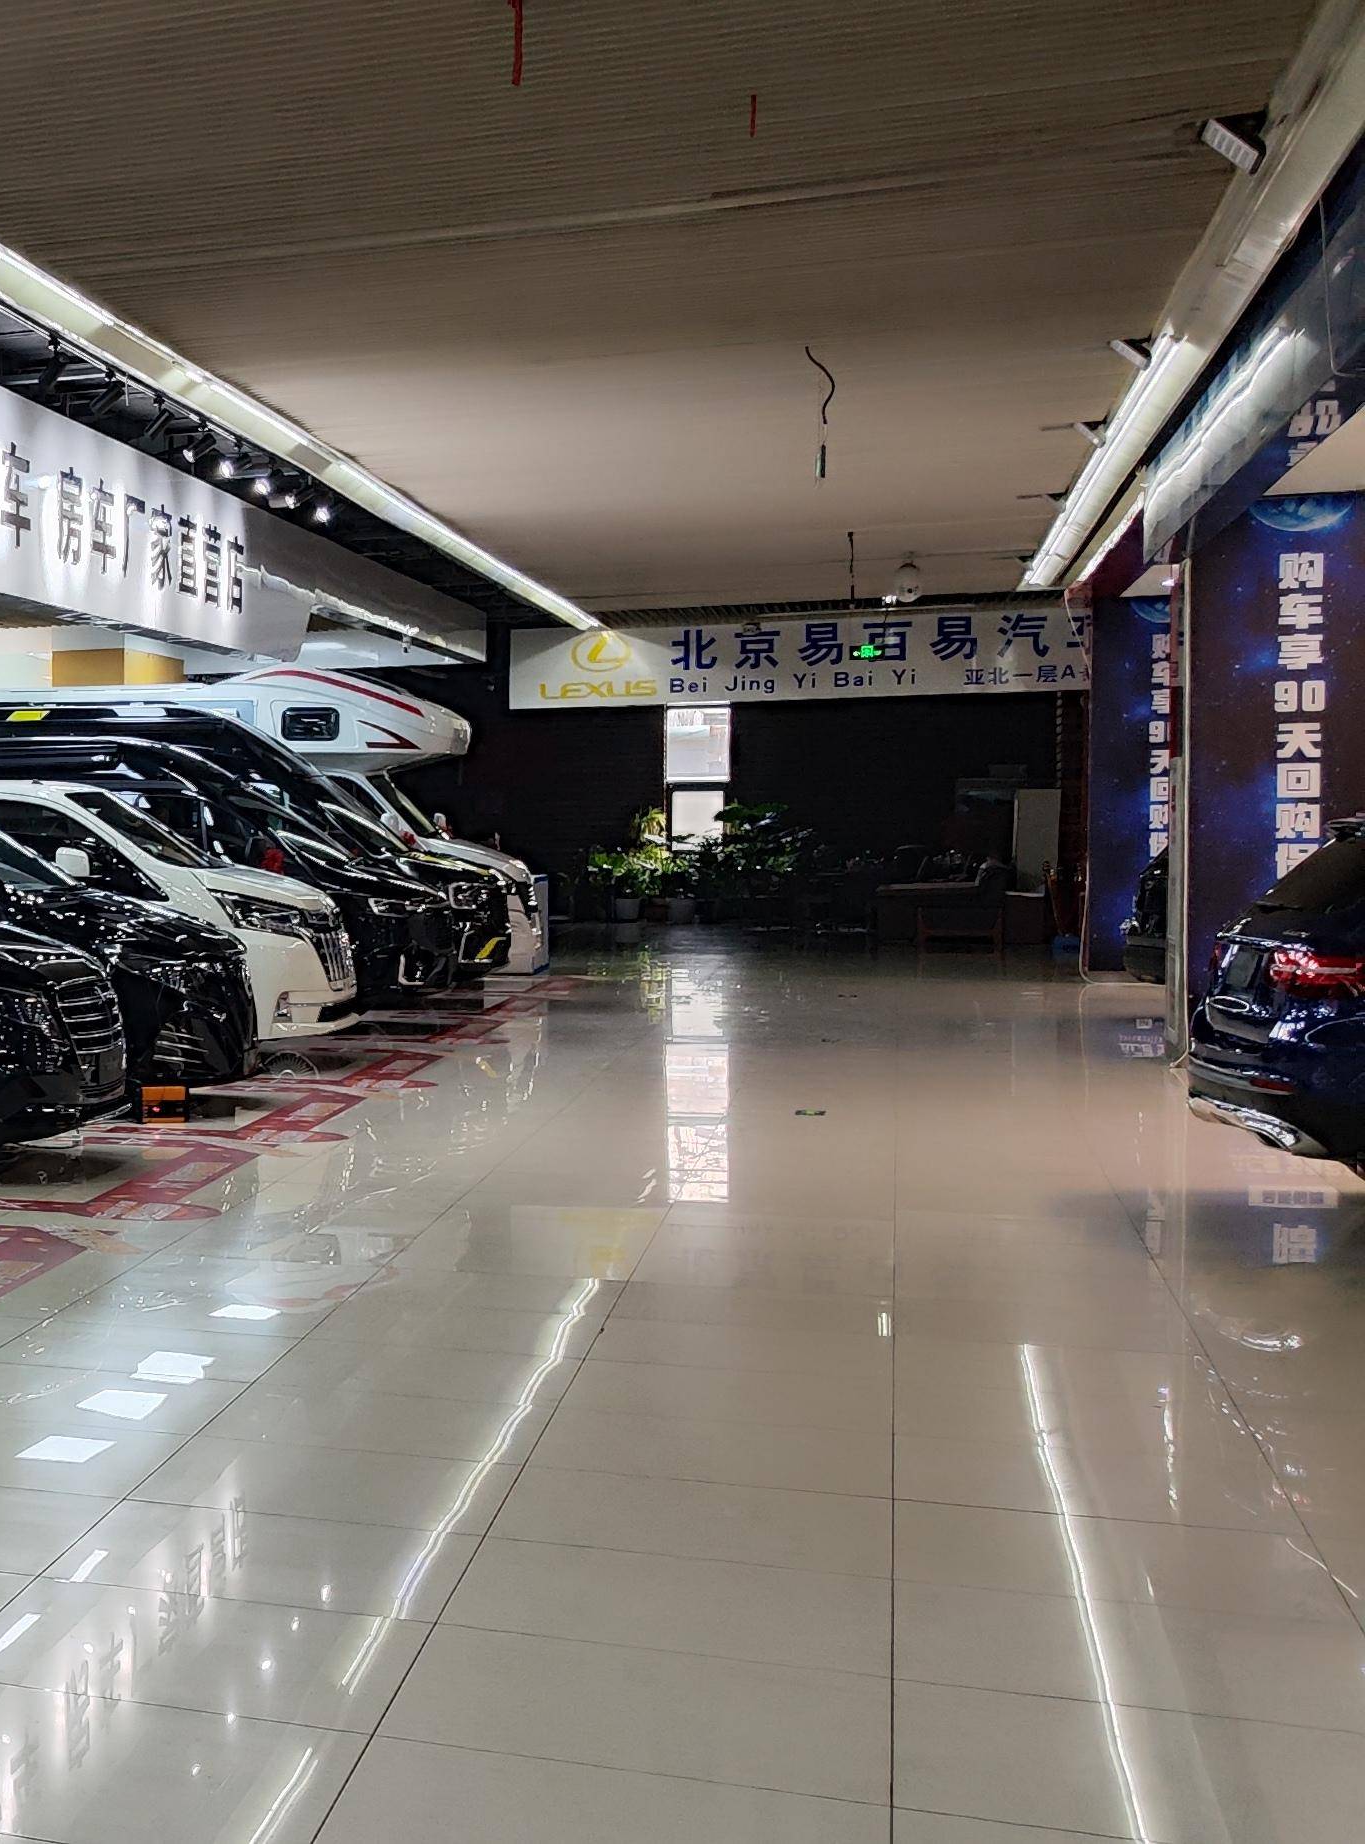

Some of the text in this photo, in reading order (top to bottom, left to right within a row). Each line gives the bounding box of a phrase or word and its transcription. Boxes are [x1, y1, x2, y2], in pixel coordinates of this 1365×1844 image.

[57, 466, 244, 614] 房车厂家直营店
[539, 679, 658, 701] LEXUS
[670, 668, 917, 694] Bei Jing Yi Bai Yi
